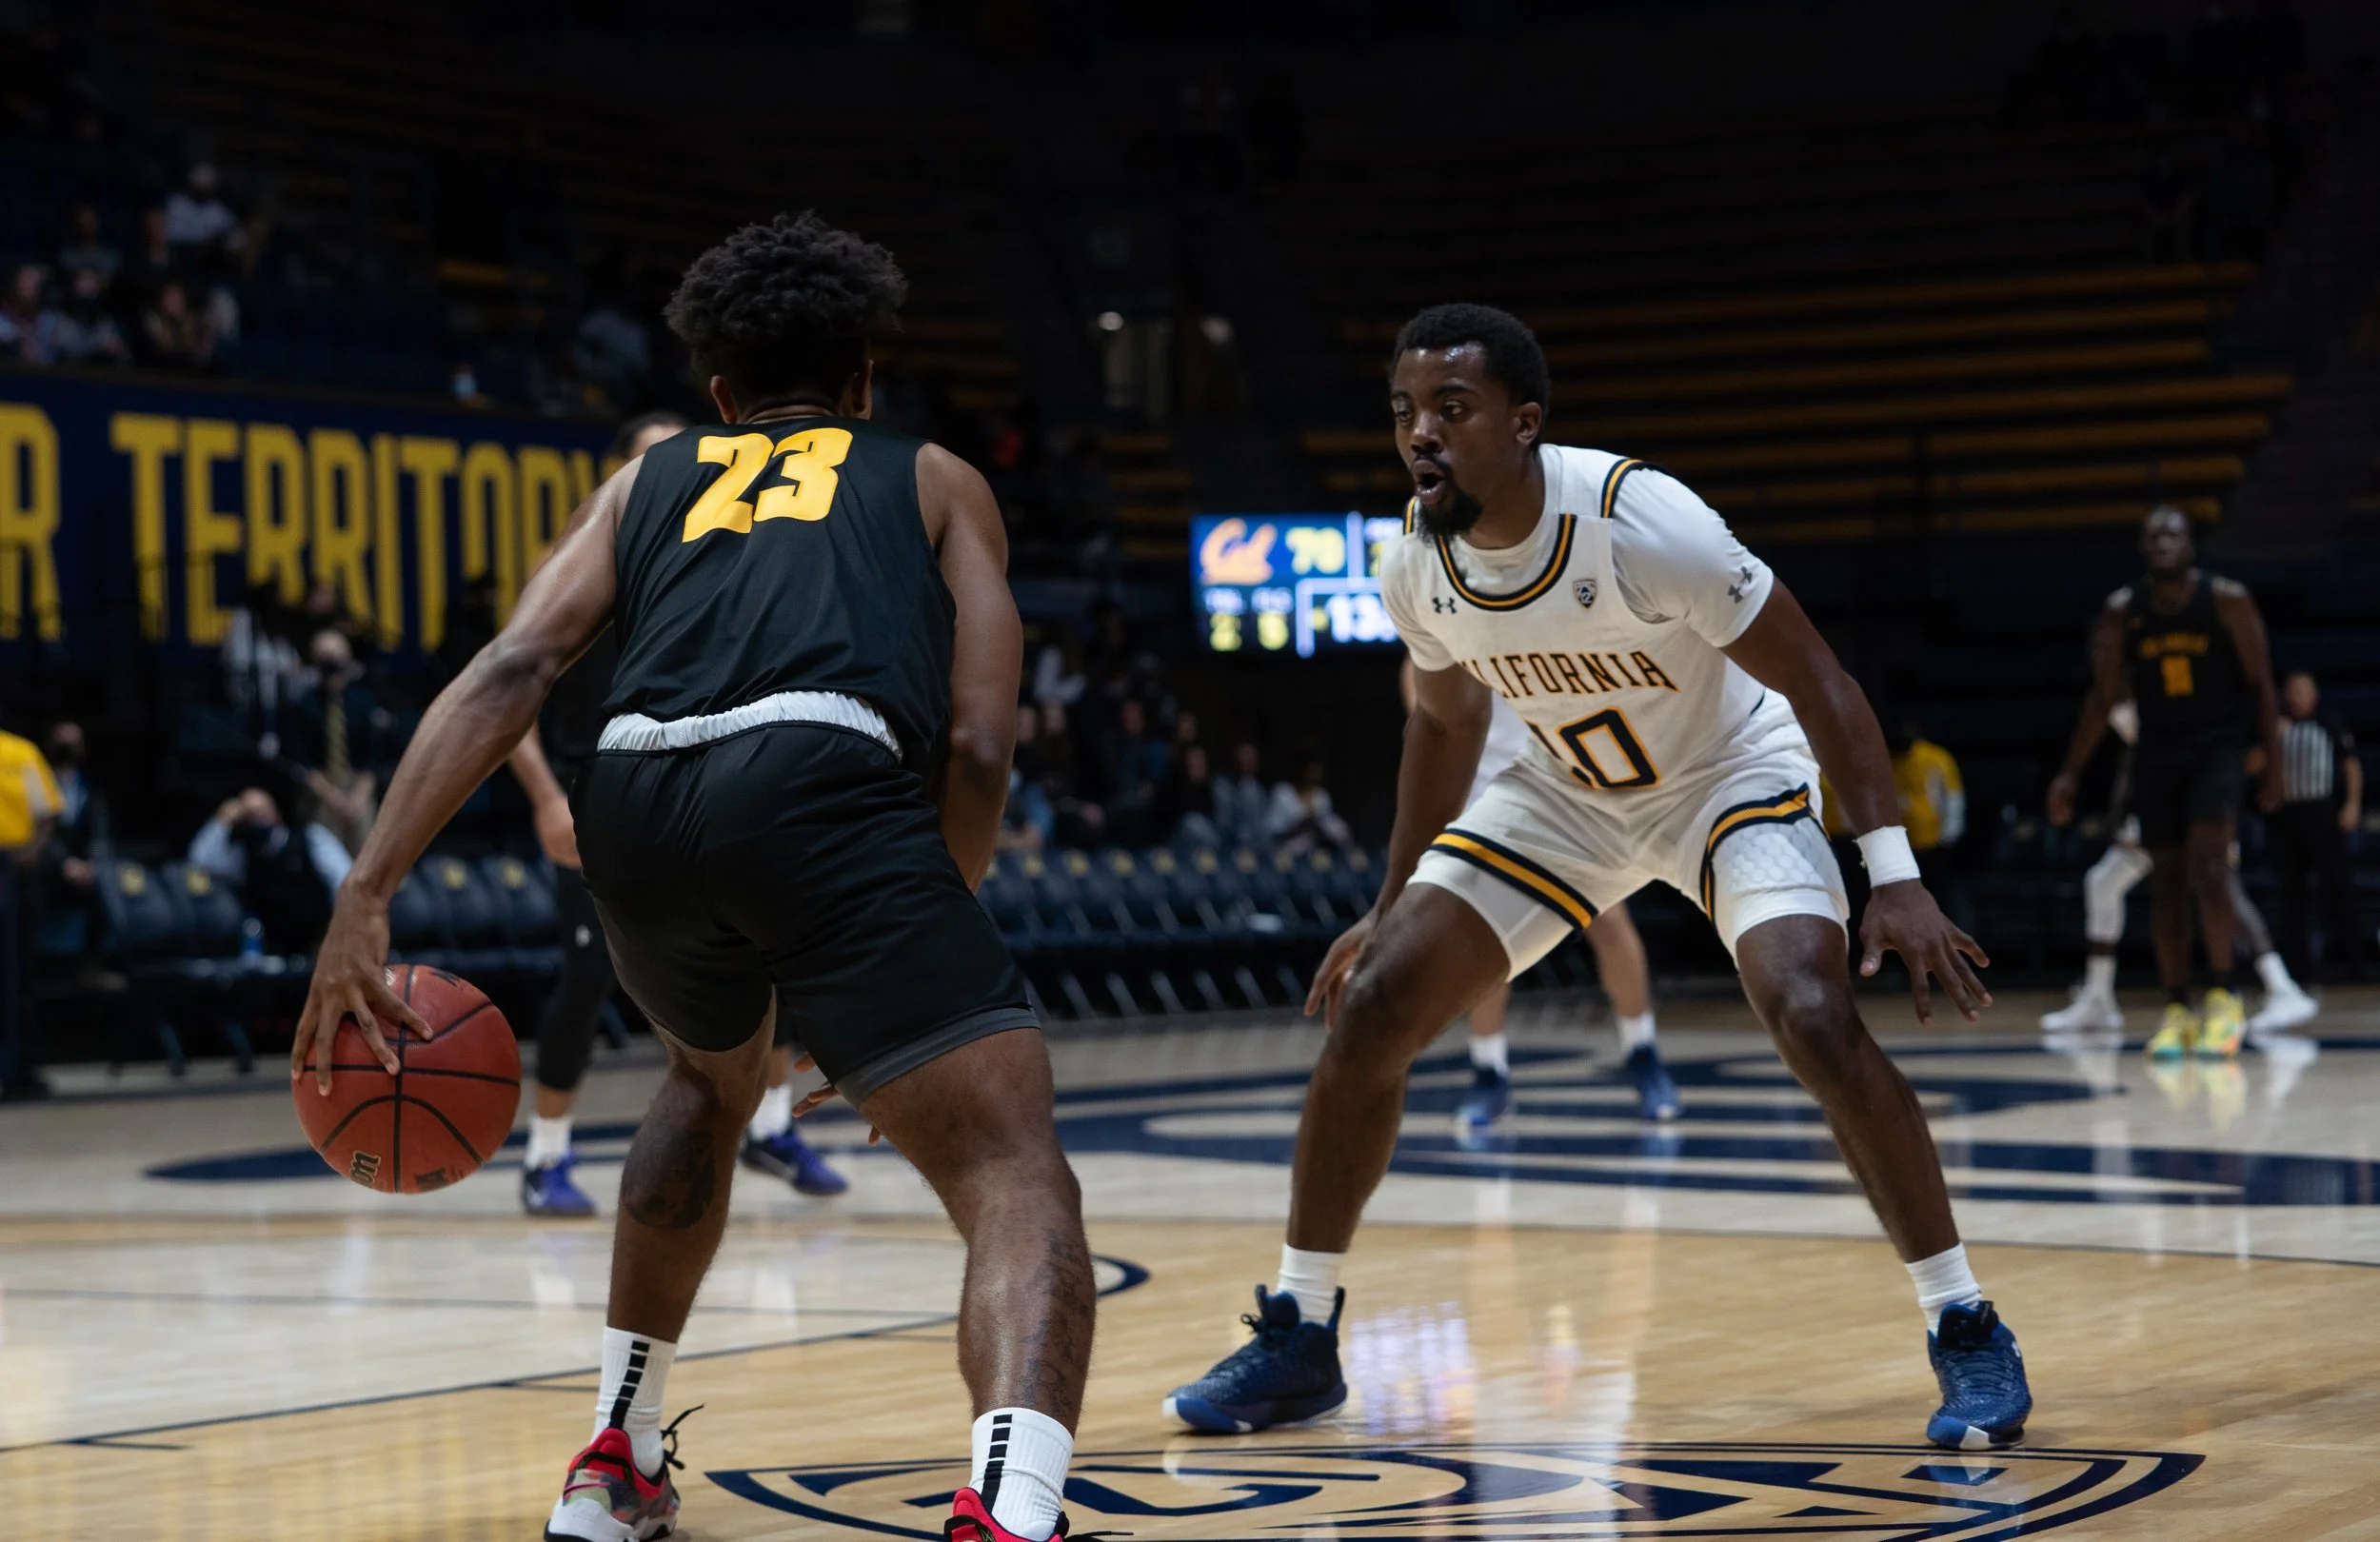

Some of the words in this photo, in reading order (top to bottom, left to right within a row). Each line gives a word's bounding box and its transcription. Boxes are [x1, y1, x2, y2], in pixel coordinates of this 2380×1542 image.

[108, 410, 625, 653] TERRITOR
[682, 427, 853, 544] 23
[1461, 650, 1680, 699] LIFORNIA
